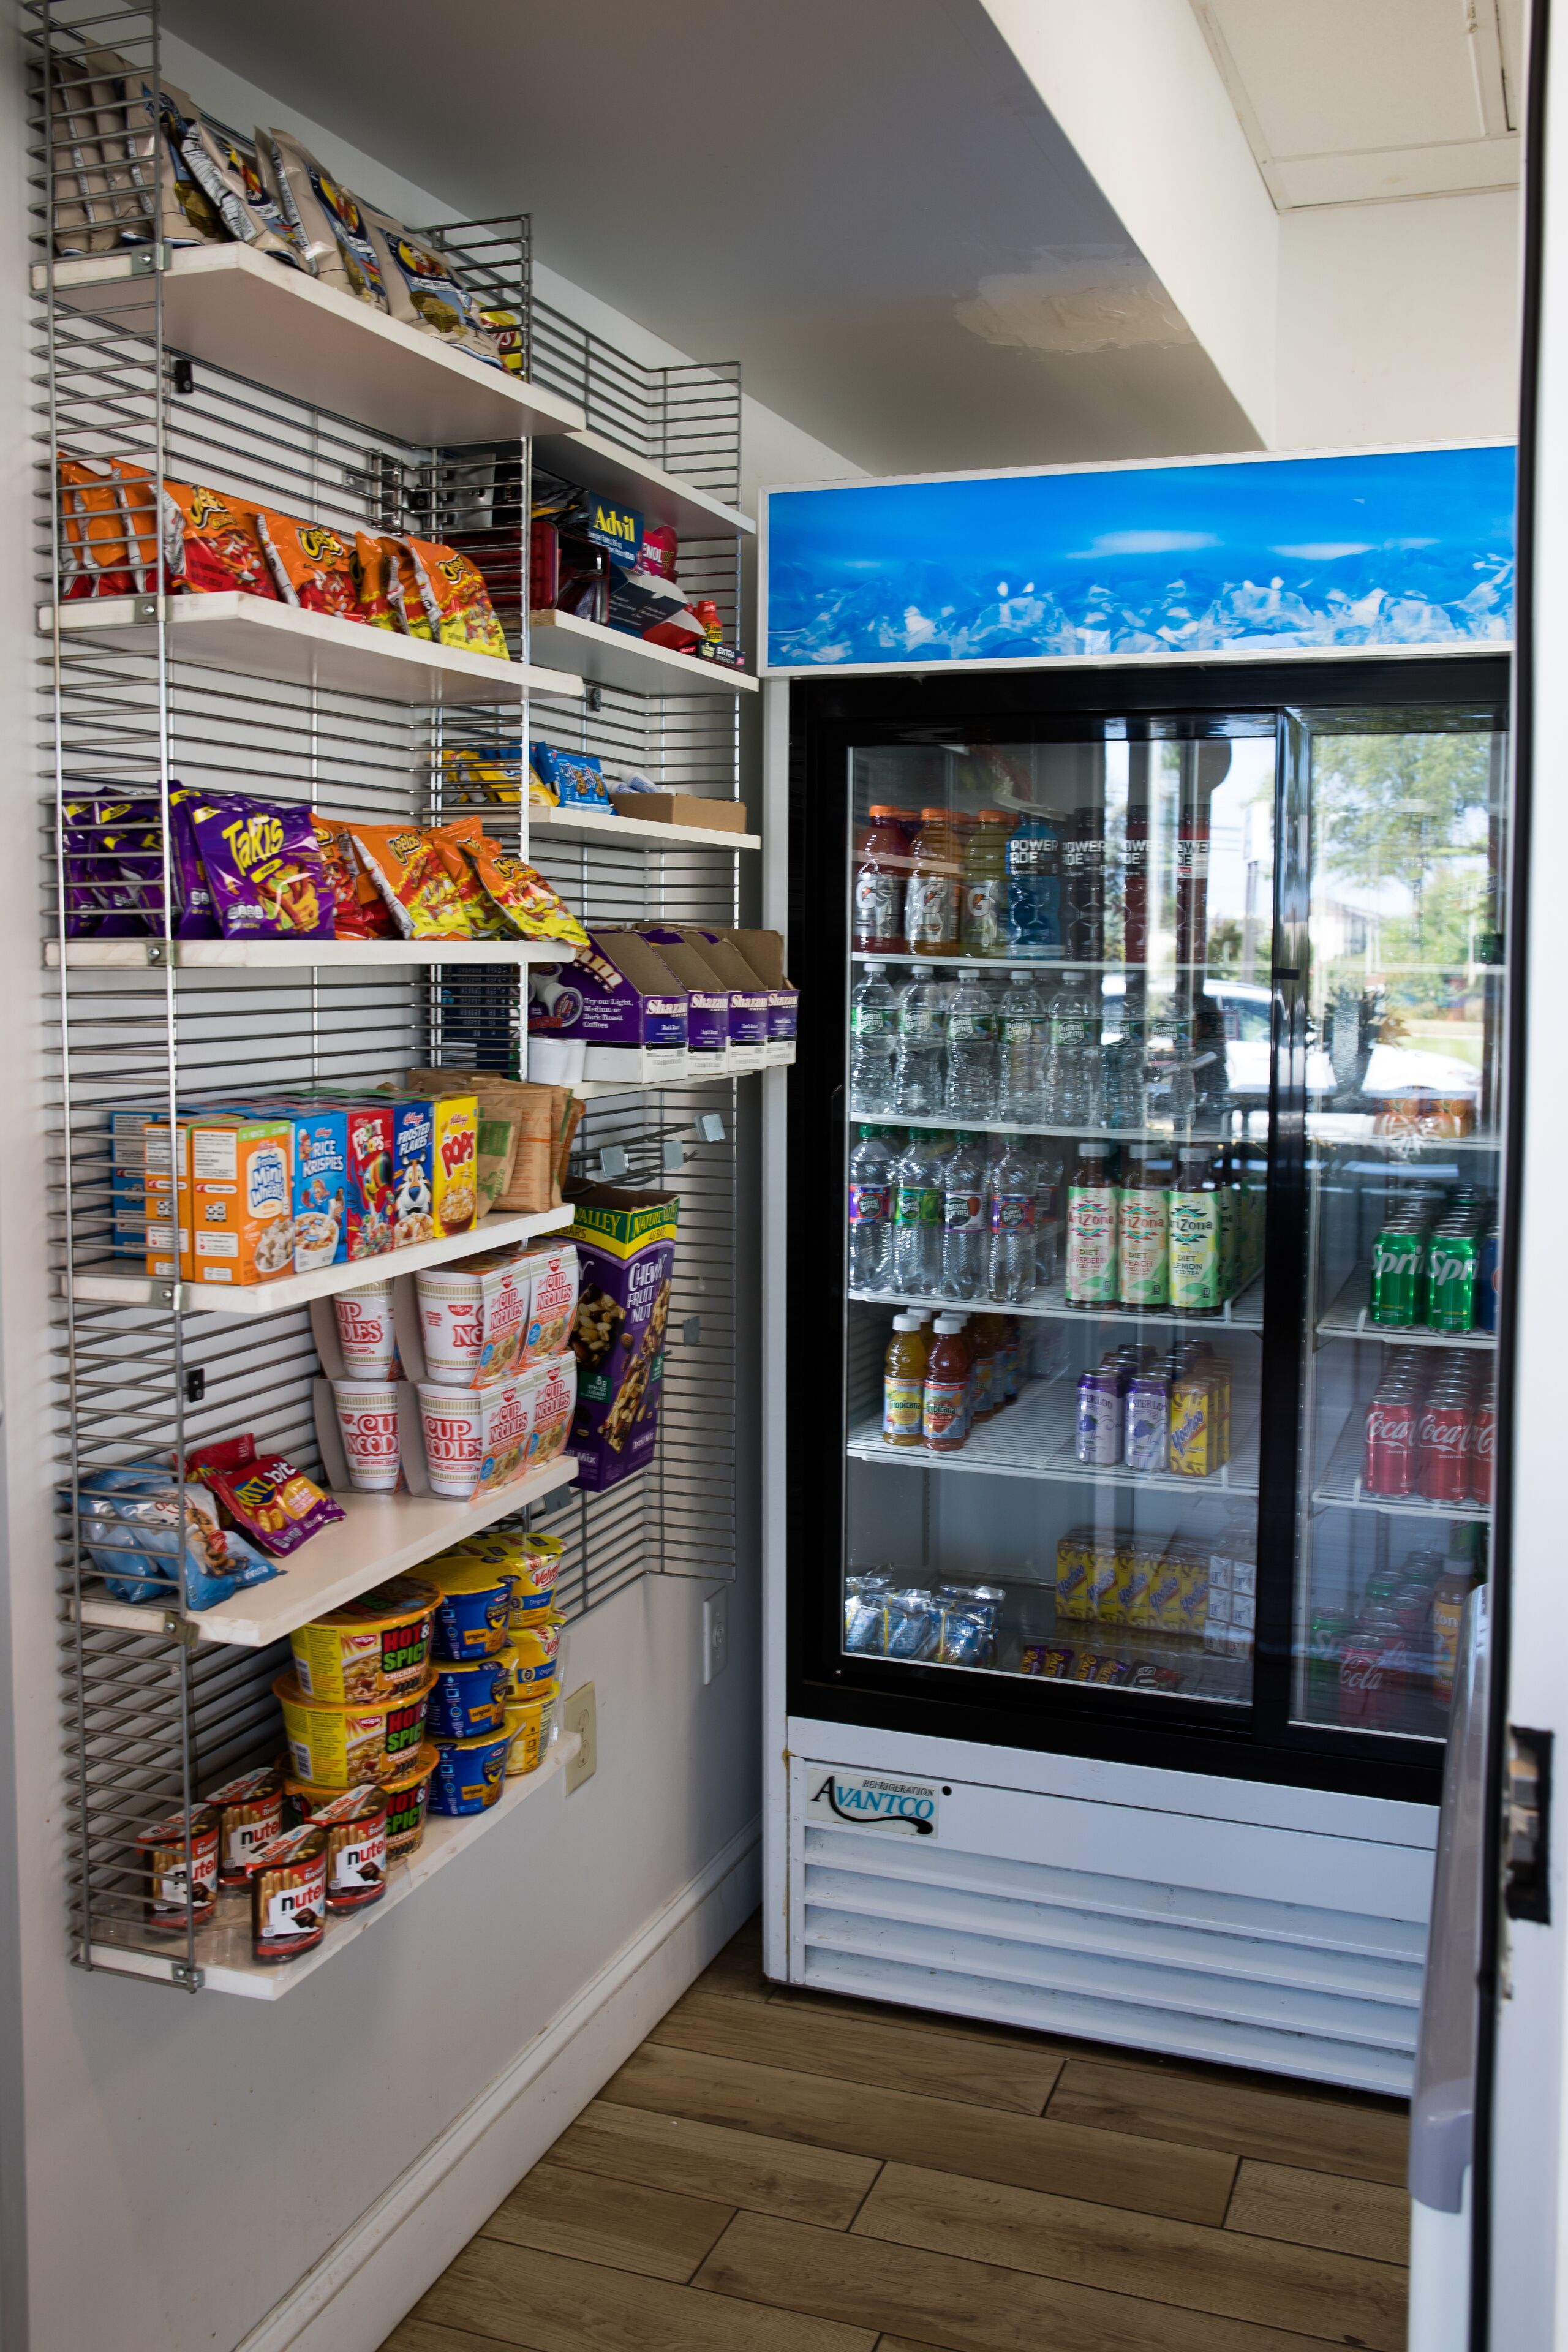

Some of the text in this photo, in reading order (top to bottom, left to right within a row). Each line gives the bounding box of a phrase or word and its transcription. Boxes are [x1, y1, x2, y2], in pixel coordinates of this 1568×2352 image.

[593, 505, 635, 543] Advil
[716, 647, 735, 659] EXTRA
[222, 818, 284, 876] Takis
[1011, 839, 1058, 851] POWER
[1010, 851, 1038, 864] ADE
[856, 880, 878, 909] G
[919, 884, 942, 914] G
[968, 886, 990, 916] G
[860, 1011, 883, 1021] Poland
[905, 1011, 929, 1021] Poland
[905, 1019, 930, 1031] Spring
[1006, 1020, 1031, 1031] Poland
[1006, 1028, 1032, 1040] Spring
[1058, 1022, 1083, 1033] Poland
[1058, 1030, 1084, 1042] Spring
[397, 1122, 430, 1145] FROSTED
[312, 1139, 336, 1157] RICE
[399, 1135, 428, 1156] FLAKES
[440, 1130, 476, 1180] POPS
[253, 1162, 282, 1185] Mini
[303, 1155, 344, 1178] KRISPIES
[575, 1207, 620, 1237] VALLEY
[632, 1212, 662, 1237] NATURE
[1068, 1213, 1114, 1226] AriZona
[1119, 1216, 1164, 1229] AriZona
[563, 1226, 587, 1238] BARS
[546, 1272, 566, 1291] CUP
[628, 1254, 667, 1291] CHEWY
[499, 1287, 519, 1310] CUP
[536, 1284, 573, 1311] NOODLES
[627, 1286, 655, 1308] FRUIT
[489, 1299, 524, 1331] NOODLES
[631, 1303, 652, 1323] NUT
[545, 1380, 565, 1401] CUP
[499, 1401, 521, 1423] CUP
[534, 1390, 571, 1421] NOODLES
[889, 1400, 921, 1410] Tropicana
[927, 1404, 956, 1414] Tropicana
[426, 1415, 472, 1439] CUP
[489, 1412, 528, 1445] NOODLES
[645, 1432, 654, 1443] Mix
[577, 1451, 597, 1464] Mix
[383, 1623, 429, 1653] HOT &
[384, 1666, 417, 1681] CHICKEN
[389, 1706, 421, 1734] HOT
[472, 1709, 491, 1717] original
[387, 1748, 416, 1762] CHICKEN
[417, 1789, 425, 1803] &
[863, 1779, 935, 1796] REFRIGERATION
[324, 1798, 352, 1815] nutella
[810, 1775, 935, 1828] AVANTCO
[259, 1839, 291, 1858] nutella
